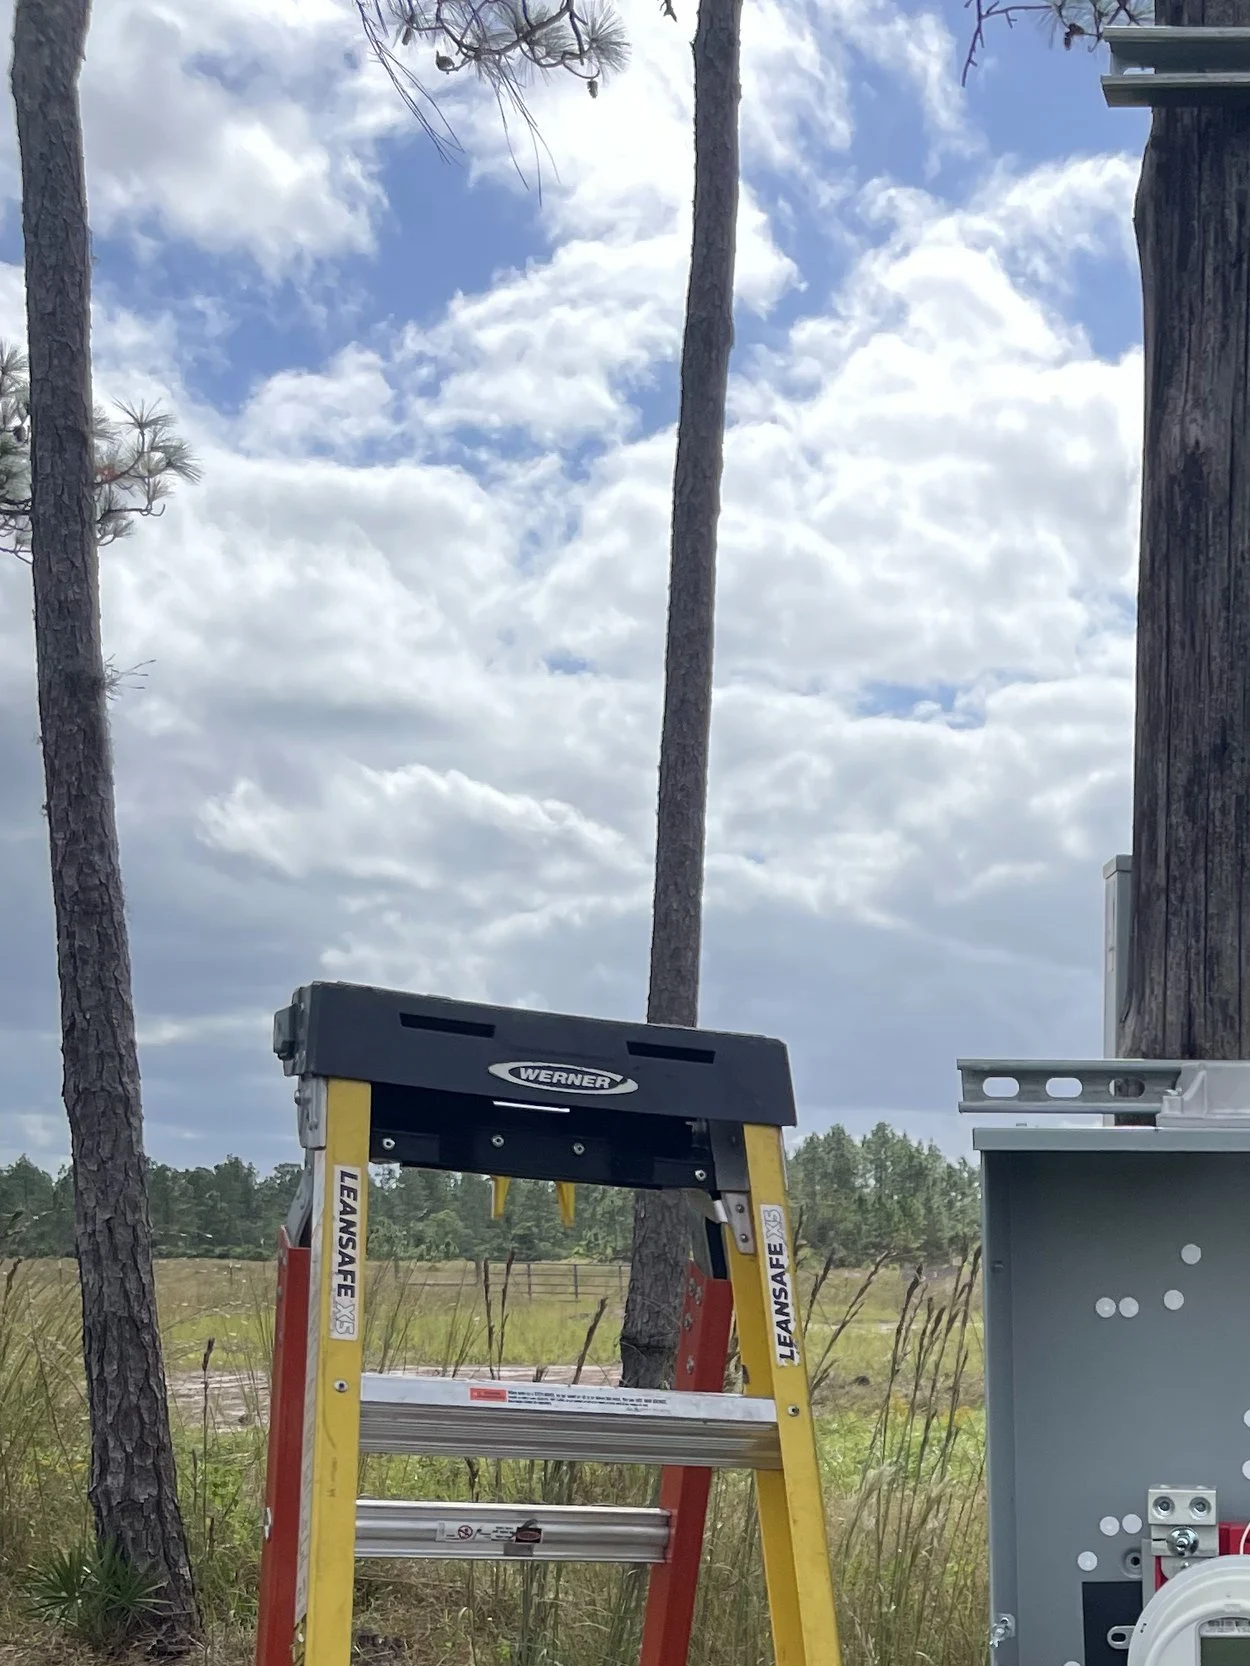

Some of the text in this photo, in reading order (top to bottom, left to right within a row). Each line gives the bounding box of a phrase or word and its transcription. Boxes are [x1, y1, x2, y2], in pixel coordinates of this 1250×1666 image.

[519, 1067, 612, 1089] WERNER
[335, 1169, 358, 1335] LEANSAFE X5
[764, 1209, 795, 1362] LEANSAFE X5
